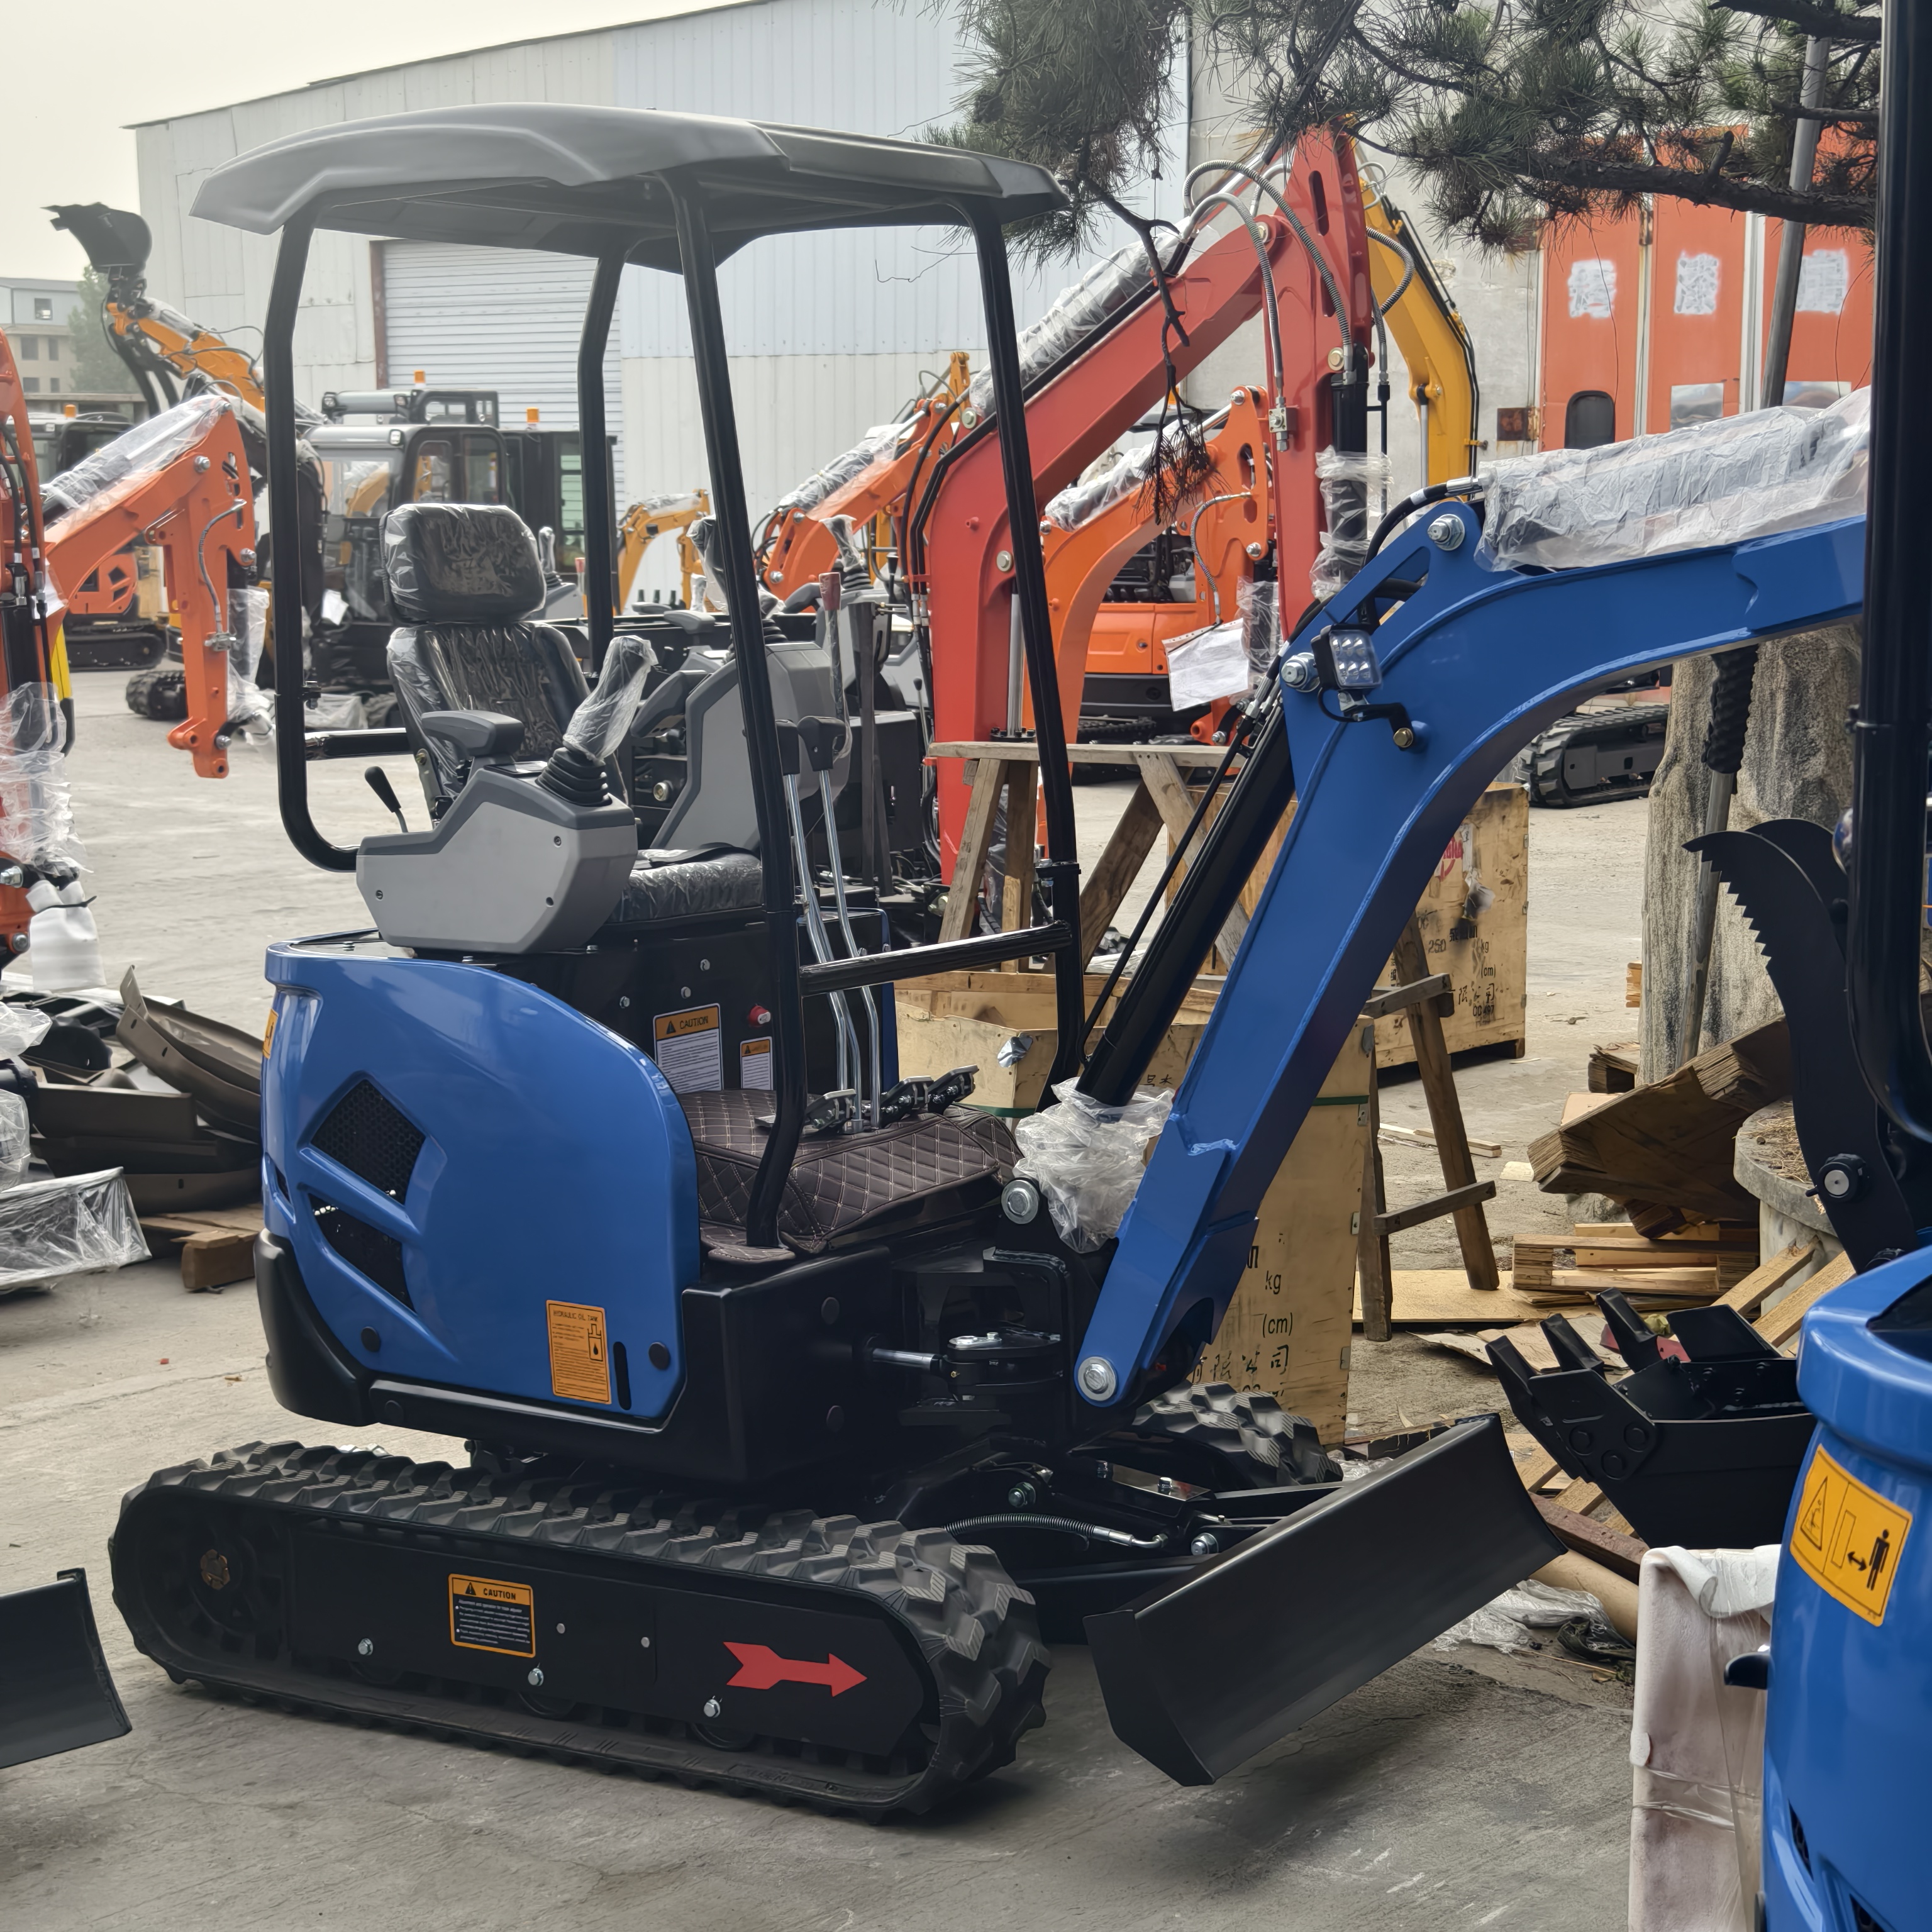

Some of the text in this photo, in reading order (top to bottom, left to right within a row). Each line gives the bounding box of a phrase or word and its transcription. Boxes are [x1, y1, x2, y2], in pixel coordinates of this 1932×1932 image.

[1481, 963, 1496, 979] (cm)
[679, 1015, 709, 1030] CAUTION
[1265, 1270, 1282, 1295] kg
[1262, 1312, 1293, 1338] (cm)
[483, 1587, 516, 1600] CAUTION
